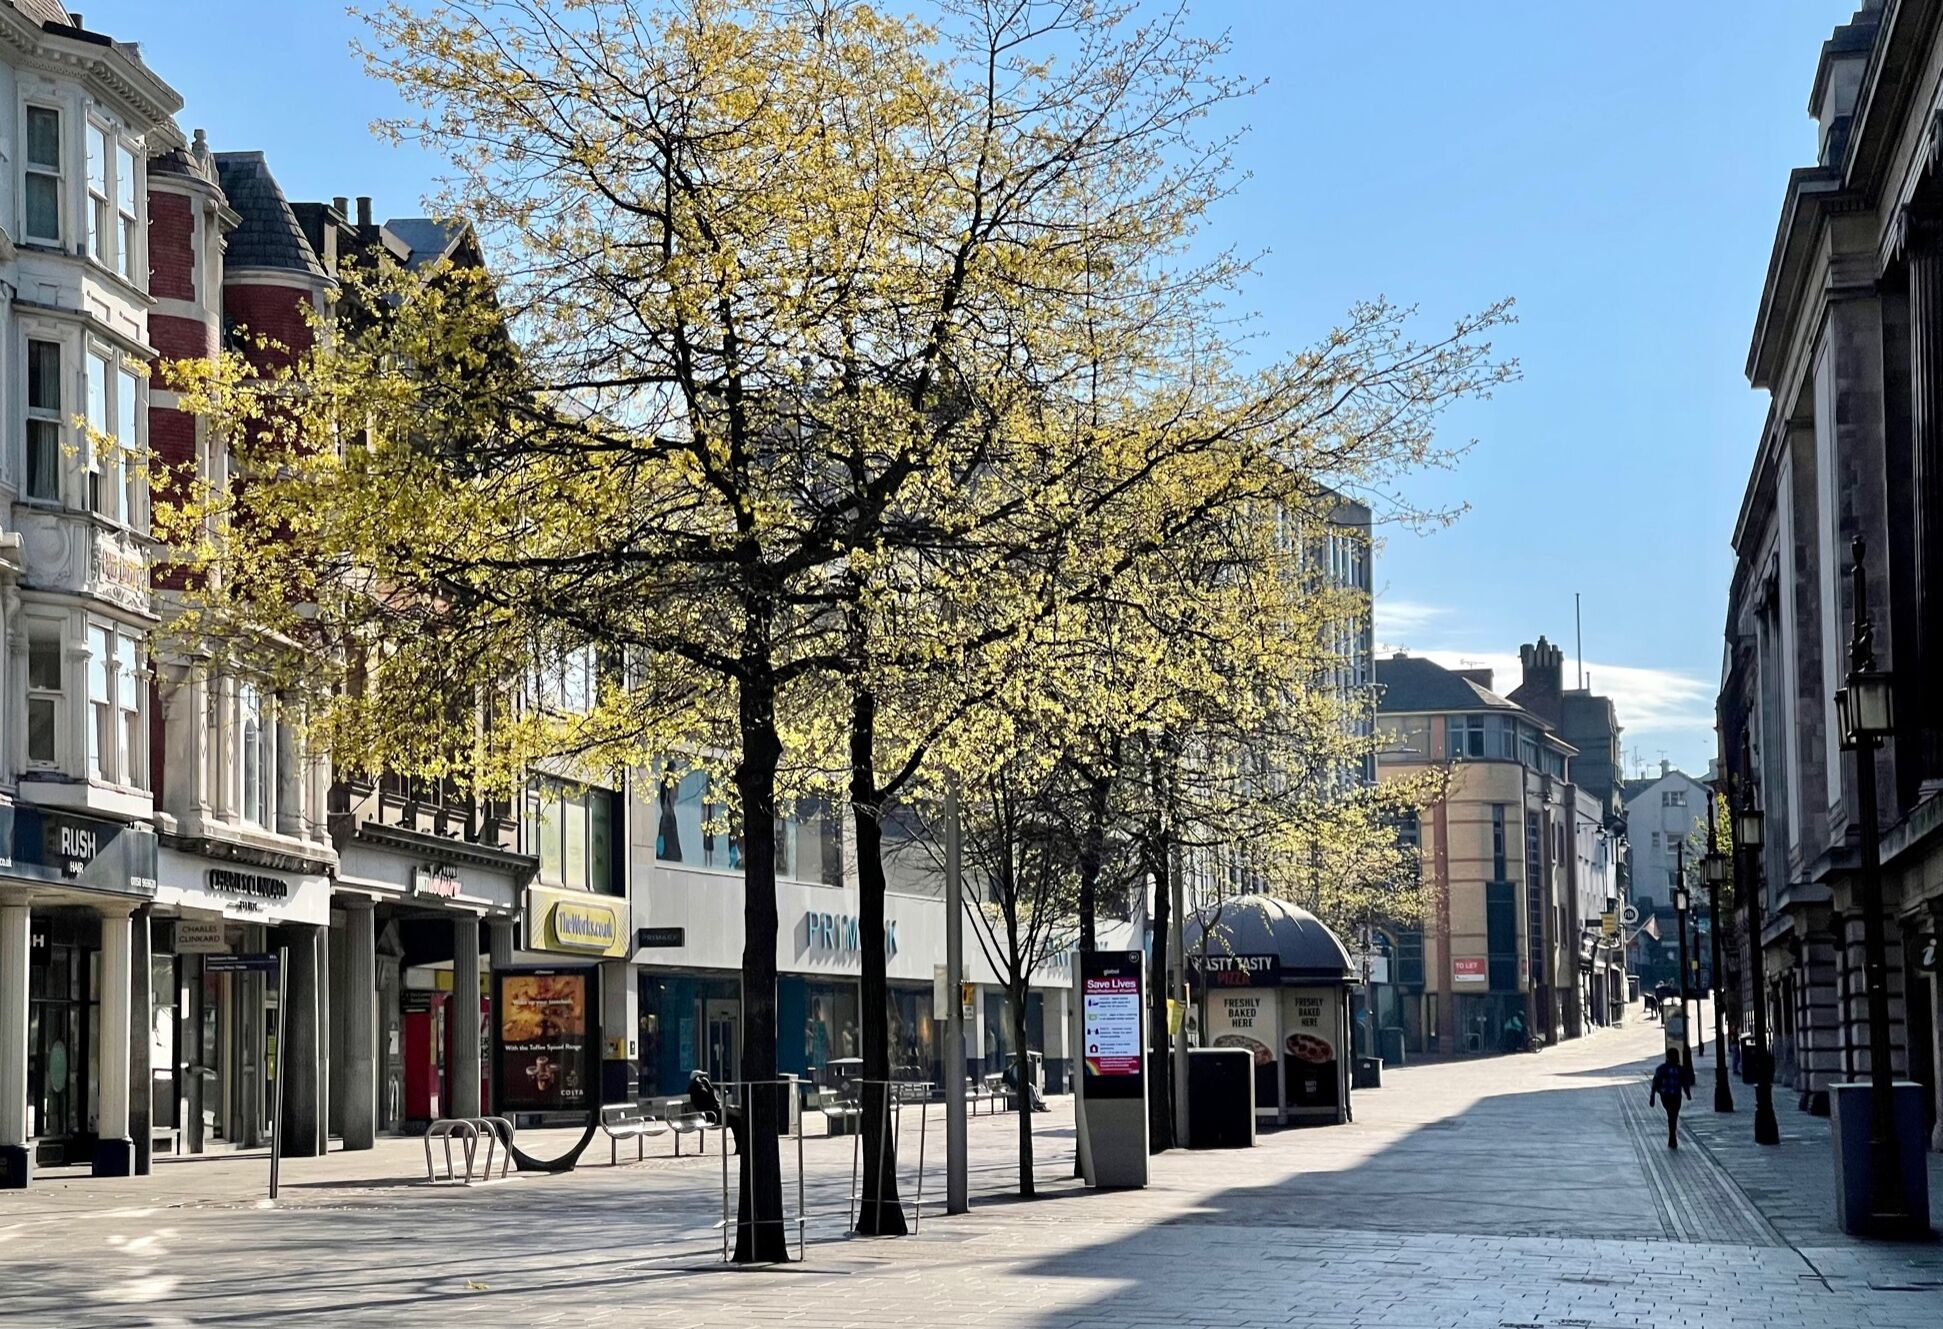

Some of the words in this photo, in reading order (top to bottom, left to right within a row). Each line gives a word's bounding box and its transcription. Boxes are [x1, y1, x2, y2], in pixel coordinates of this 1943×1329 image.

[61, 827, 96, 859] RUSH
[69, 861, 84, 874] HAIR
[182, 925, 217, 933] CHARLES
[807, 911, 898, 955] PRIMK
[179, 935, 220, 943] CLINKARD
[1193, 957, 1232, 971] ASTY
[1235, 957, 1272, 970] TASTY
[1087, 979, 1110, 989] Save
[1111, 979, 1136, 989] Lives
[1224, 998, 1261, 1008] FRESHLY
[1295, 997, 1324, 1007] FRESHLY
[1228, 1008, 1257, 1018] BAKED
[1298, 1007, 1321, 1017] BAKED
[1232, 1018, 1253, 1028] HERE
[1301, 1018, 1318, 1027] HERE
